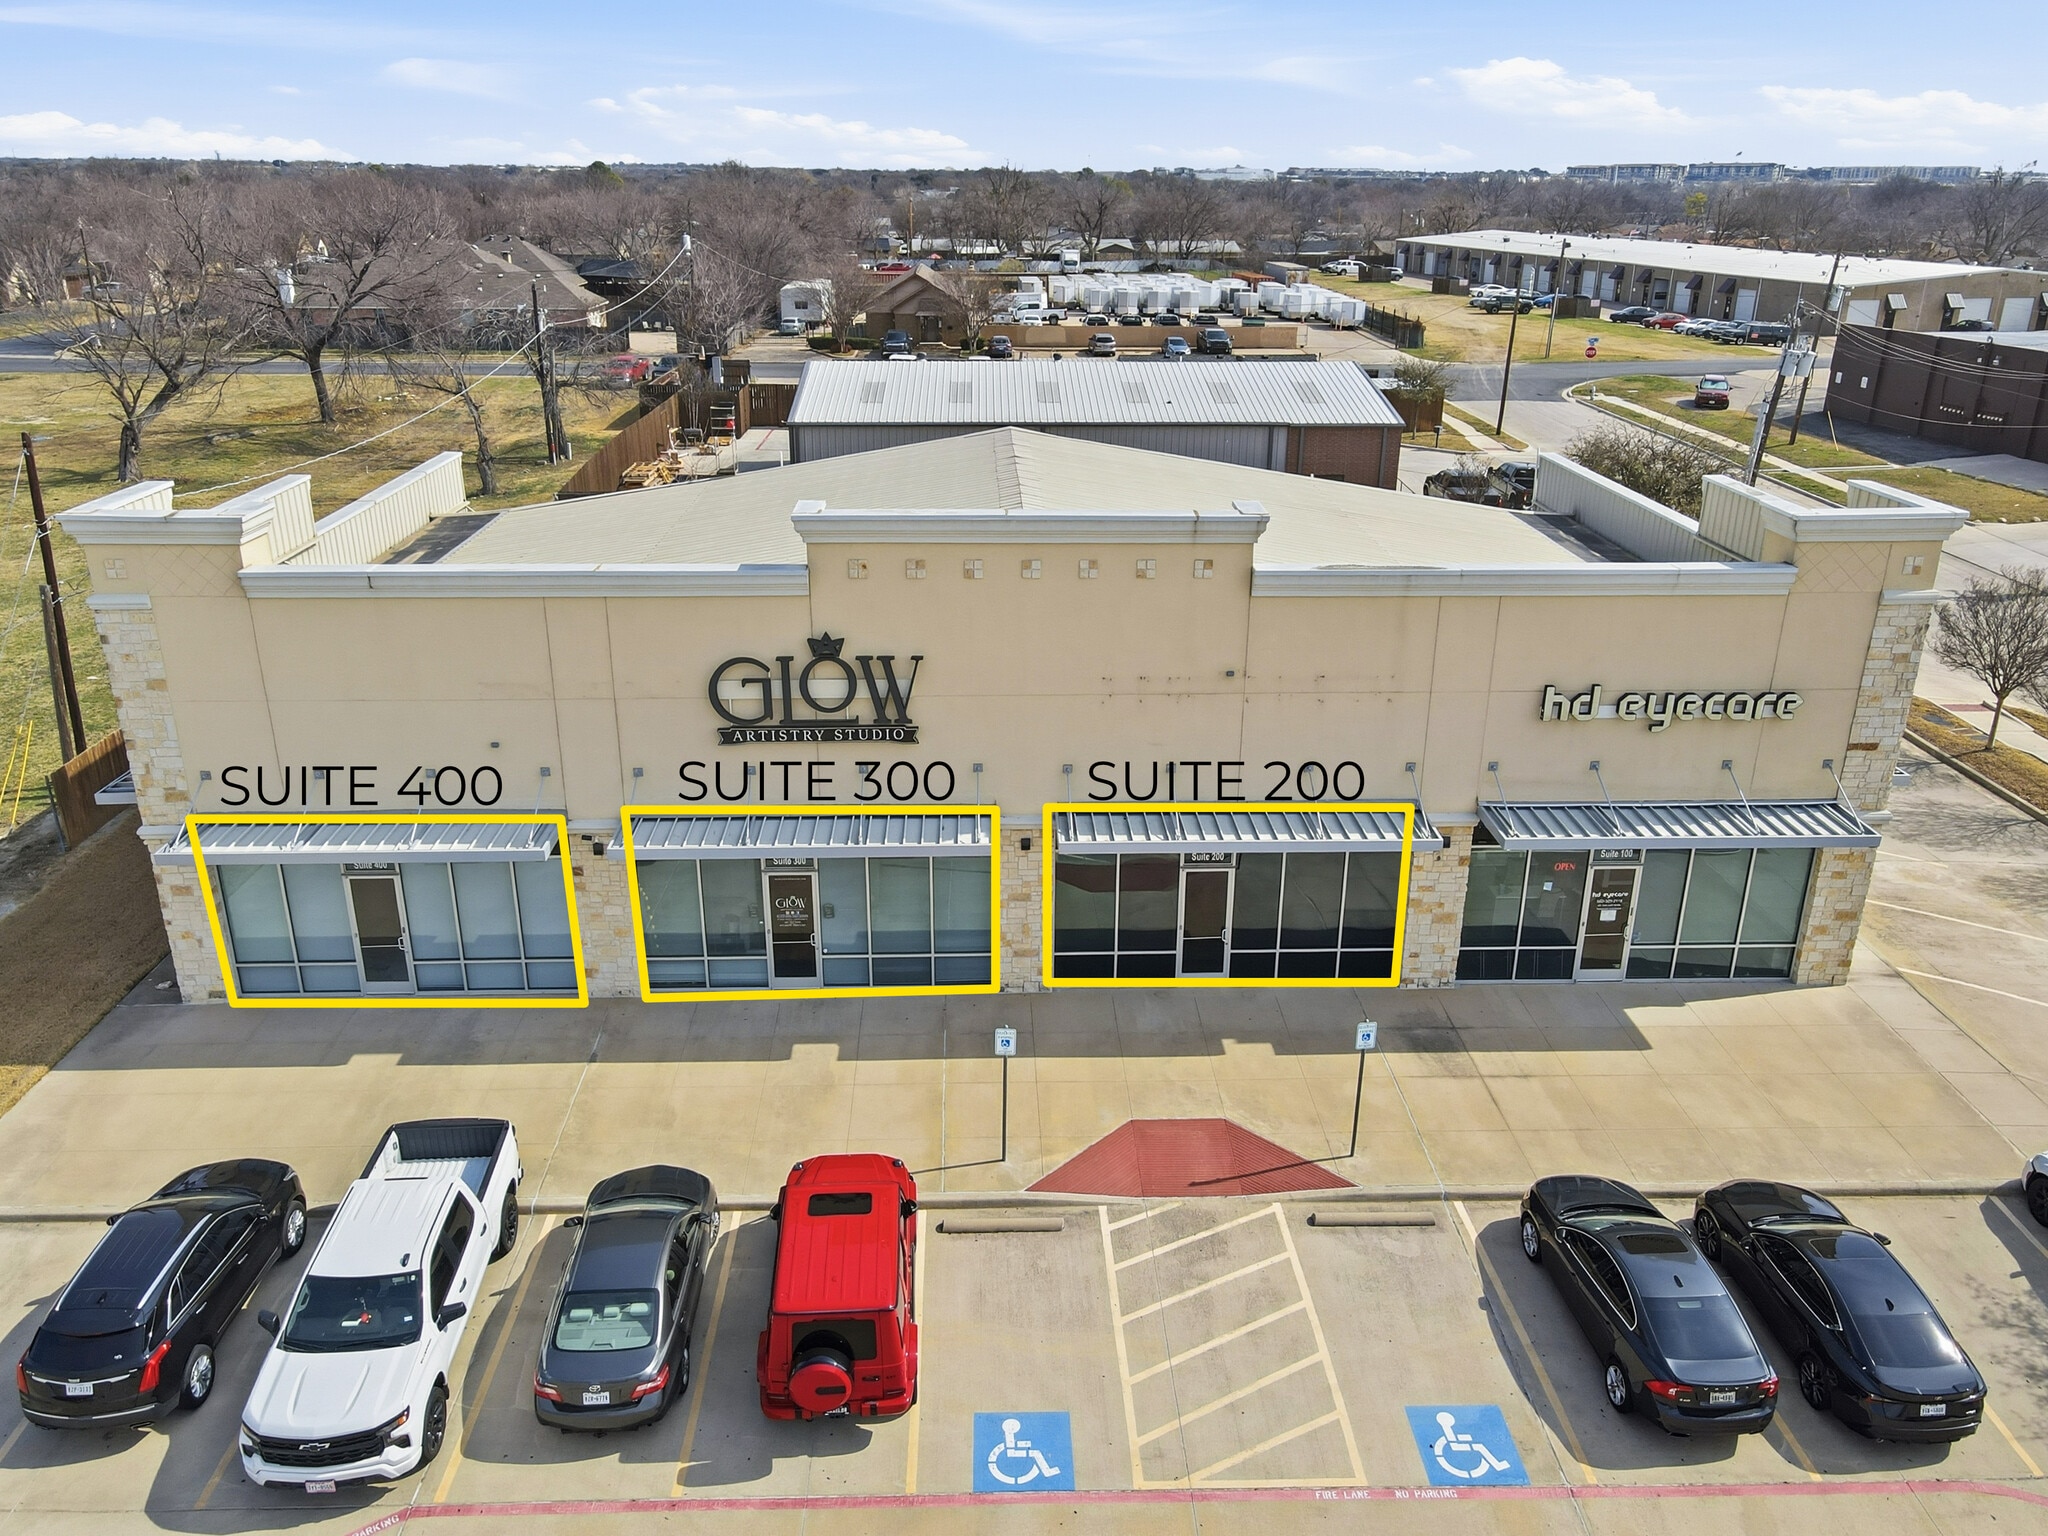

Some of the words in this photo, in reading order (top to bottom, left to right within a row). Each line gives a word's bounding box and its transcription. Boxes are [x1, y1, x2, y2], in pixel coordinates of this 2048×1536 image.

[708, 655, 924, 725] GLOW
[1540, 684, 1602, 721] hd
[1616, 691, 1804, 733] eyecare
[733, 730, 824, 742] ARTISTRY
[834, 729, 904, 741] STUDIO
[1191, 853, 1210, 861] Suite
[1211, 853, 1224, 861] 200
[1600, 850, 1619, 858] Suite
[1621, 849, 1633, 858] 100
[1554, 863, 1576, 871] OPEN
[1315, 1490, 1339, 1499] FIRE
[1344, 1490, 1371, 1499] LANE
[1395, 1490, 1409, 1499] NO
[1415, 1490, 1458, 1498] PARKING
